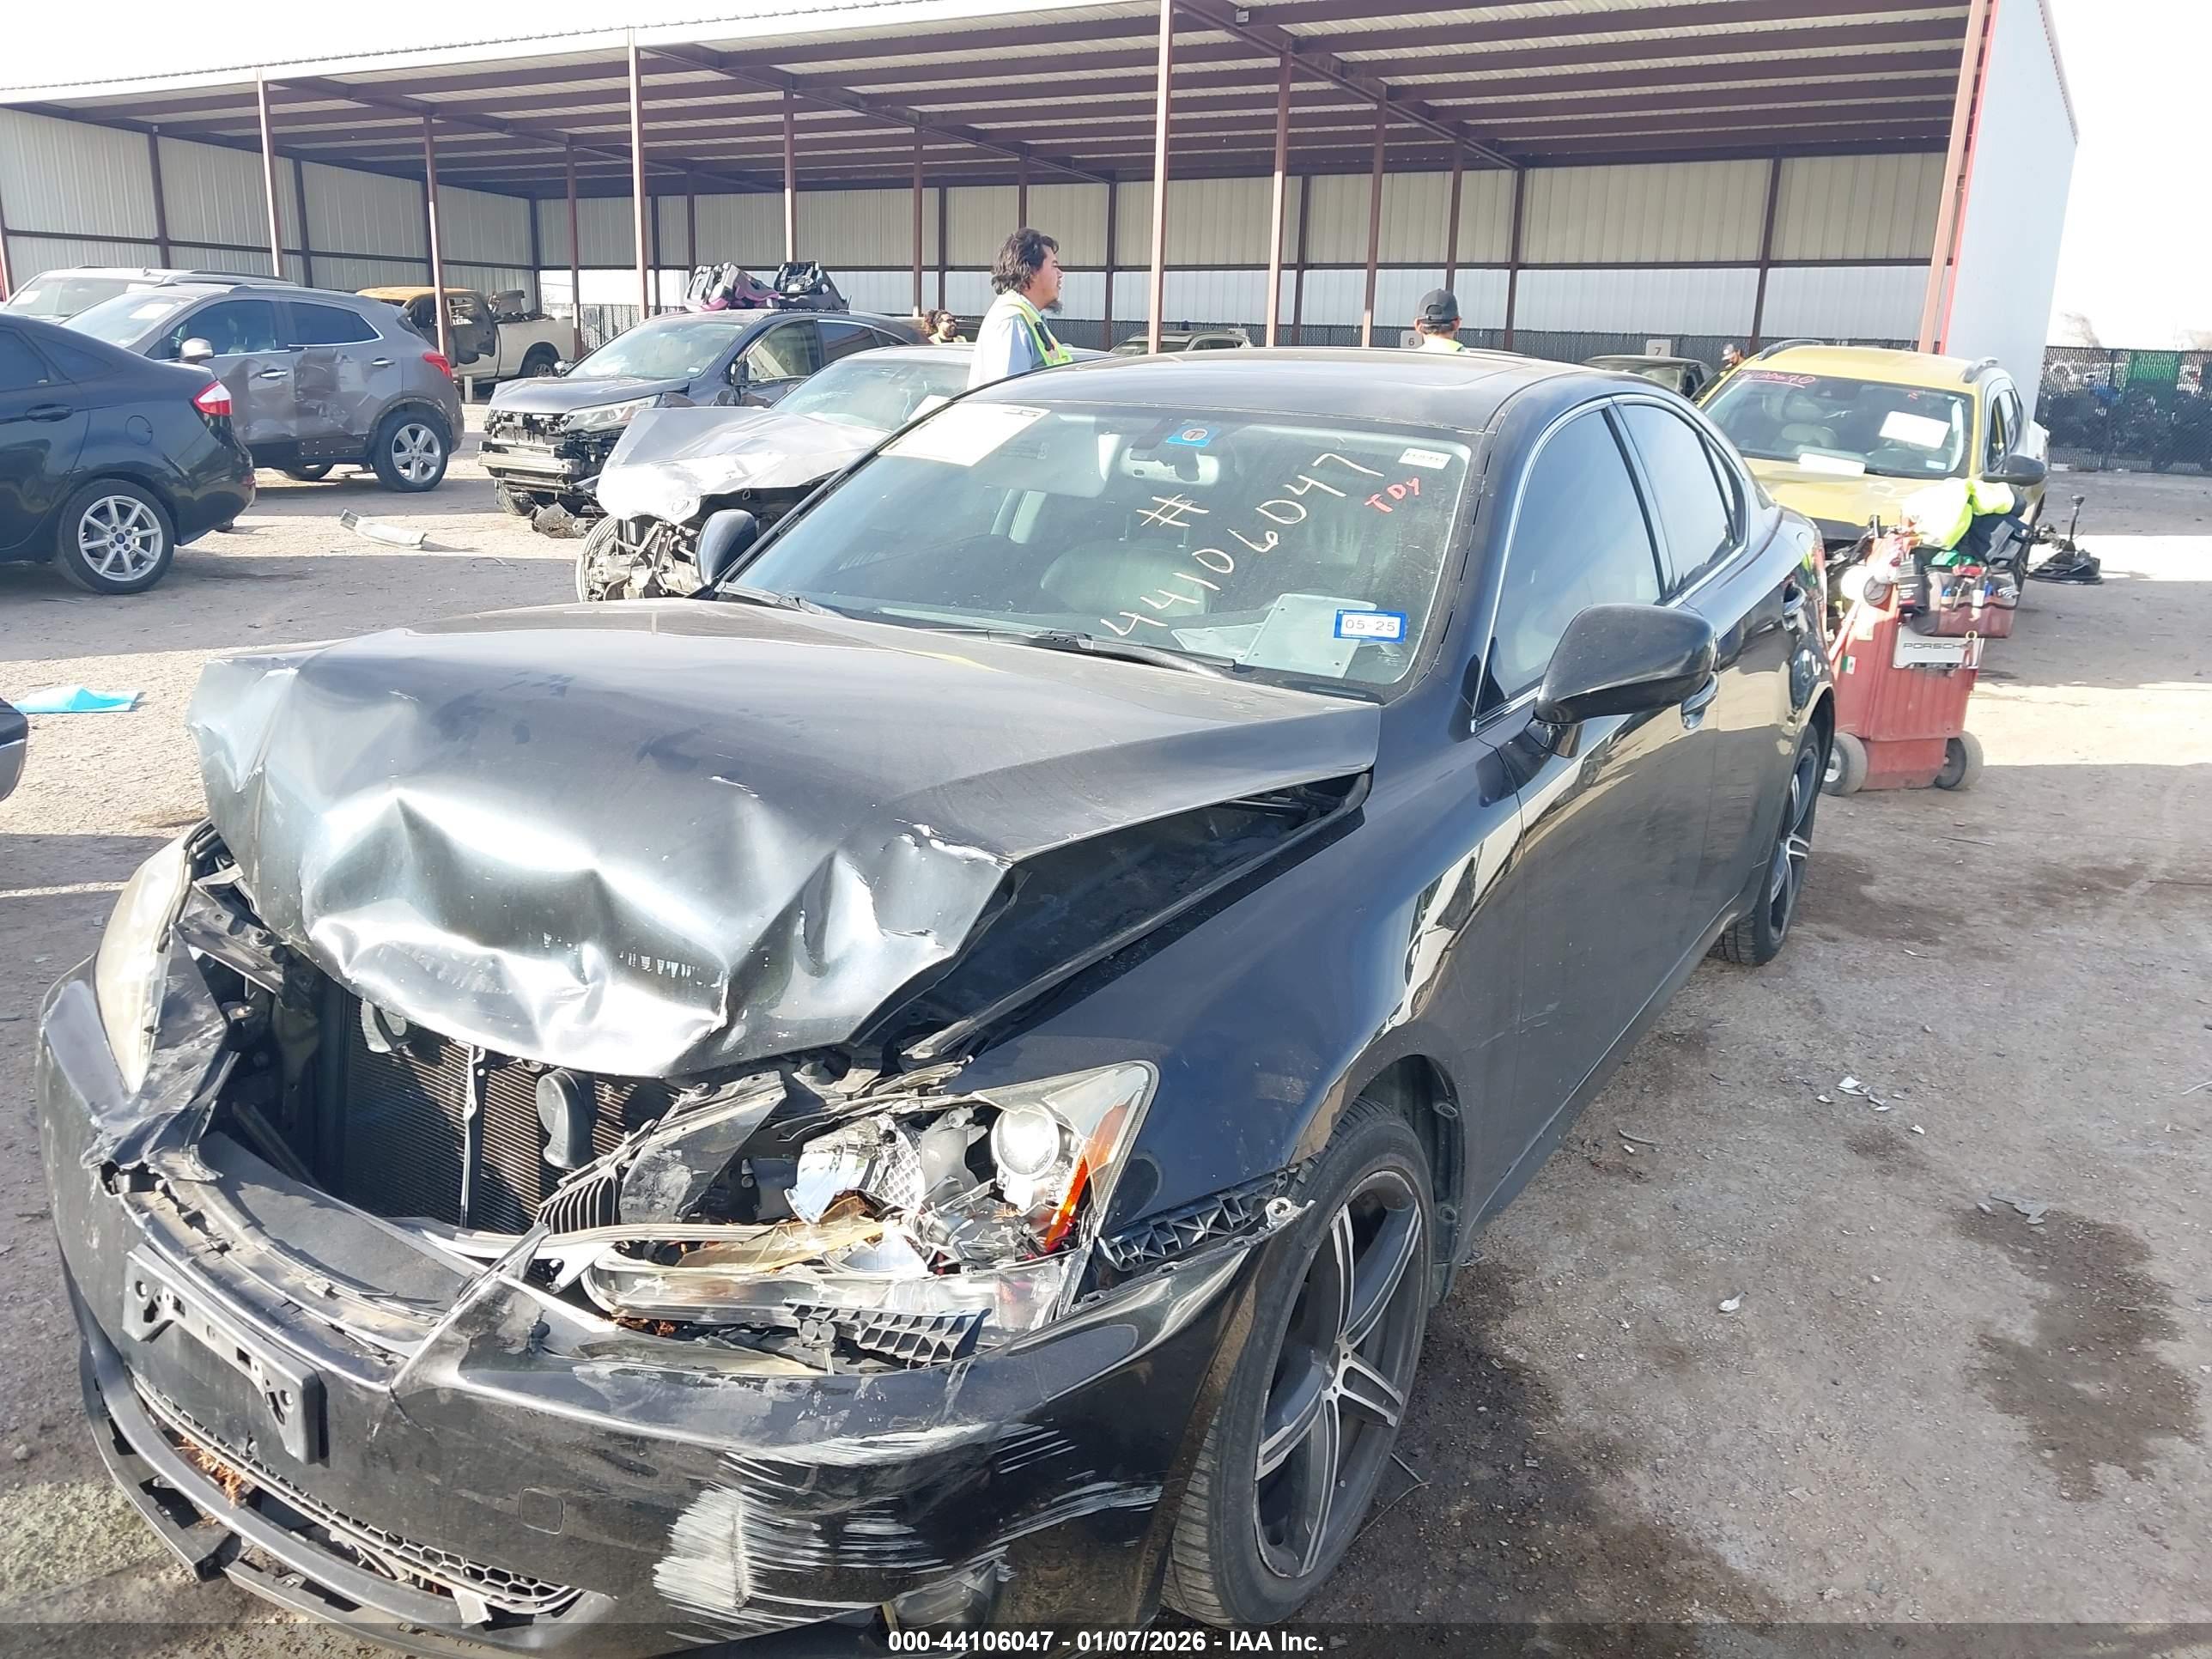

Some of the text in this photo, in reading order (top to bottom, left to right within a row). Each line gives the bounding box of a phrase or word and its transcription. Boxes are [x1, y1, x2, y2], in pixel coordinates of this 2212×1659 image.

[1408, 337, 1415, 346] 6
[1655, 347, 1662, 356] 7
[1100, 453, 1384, 636] 44106047
[1346, 619, 1395, 632] 05-25
